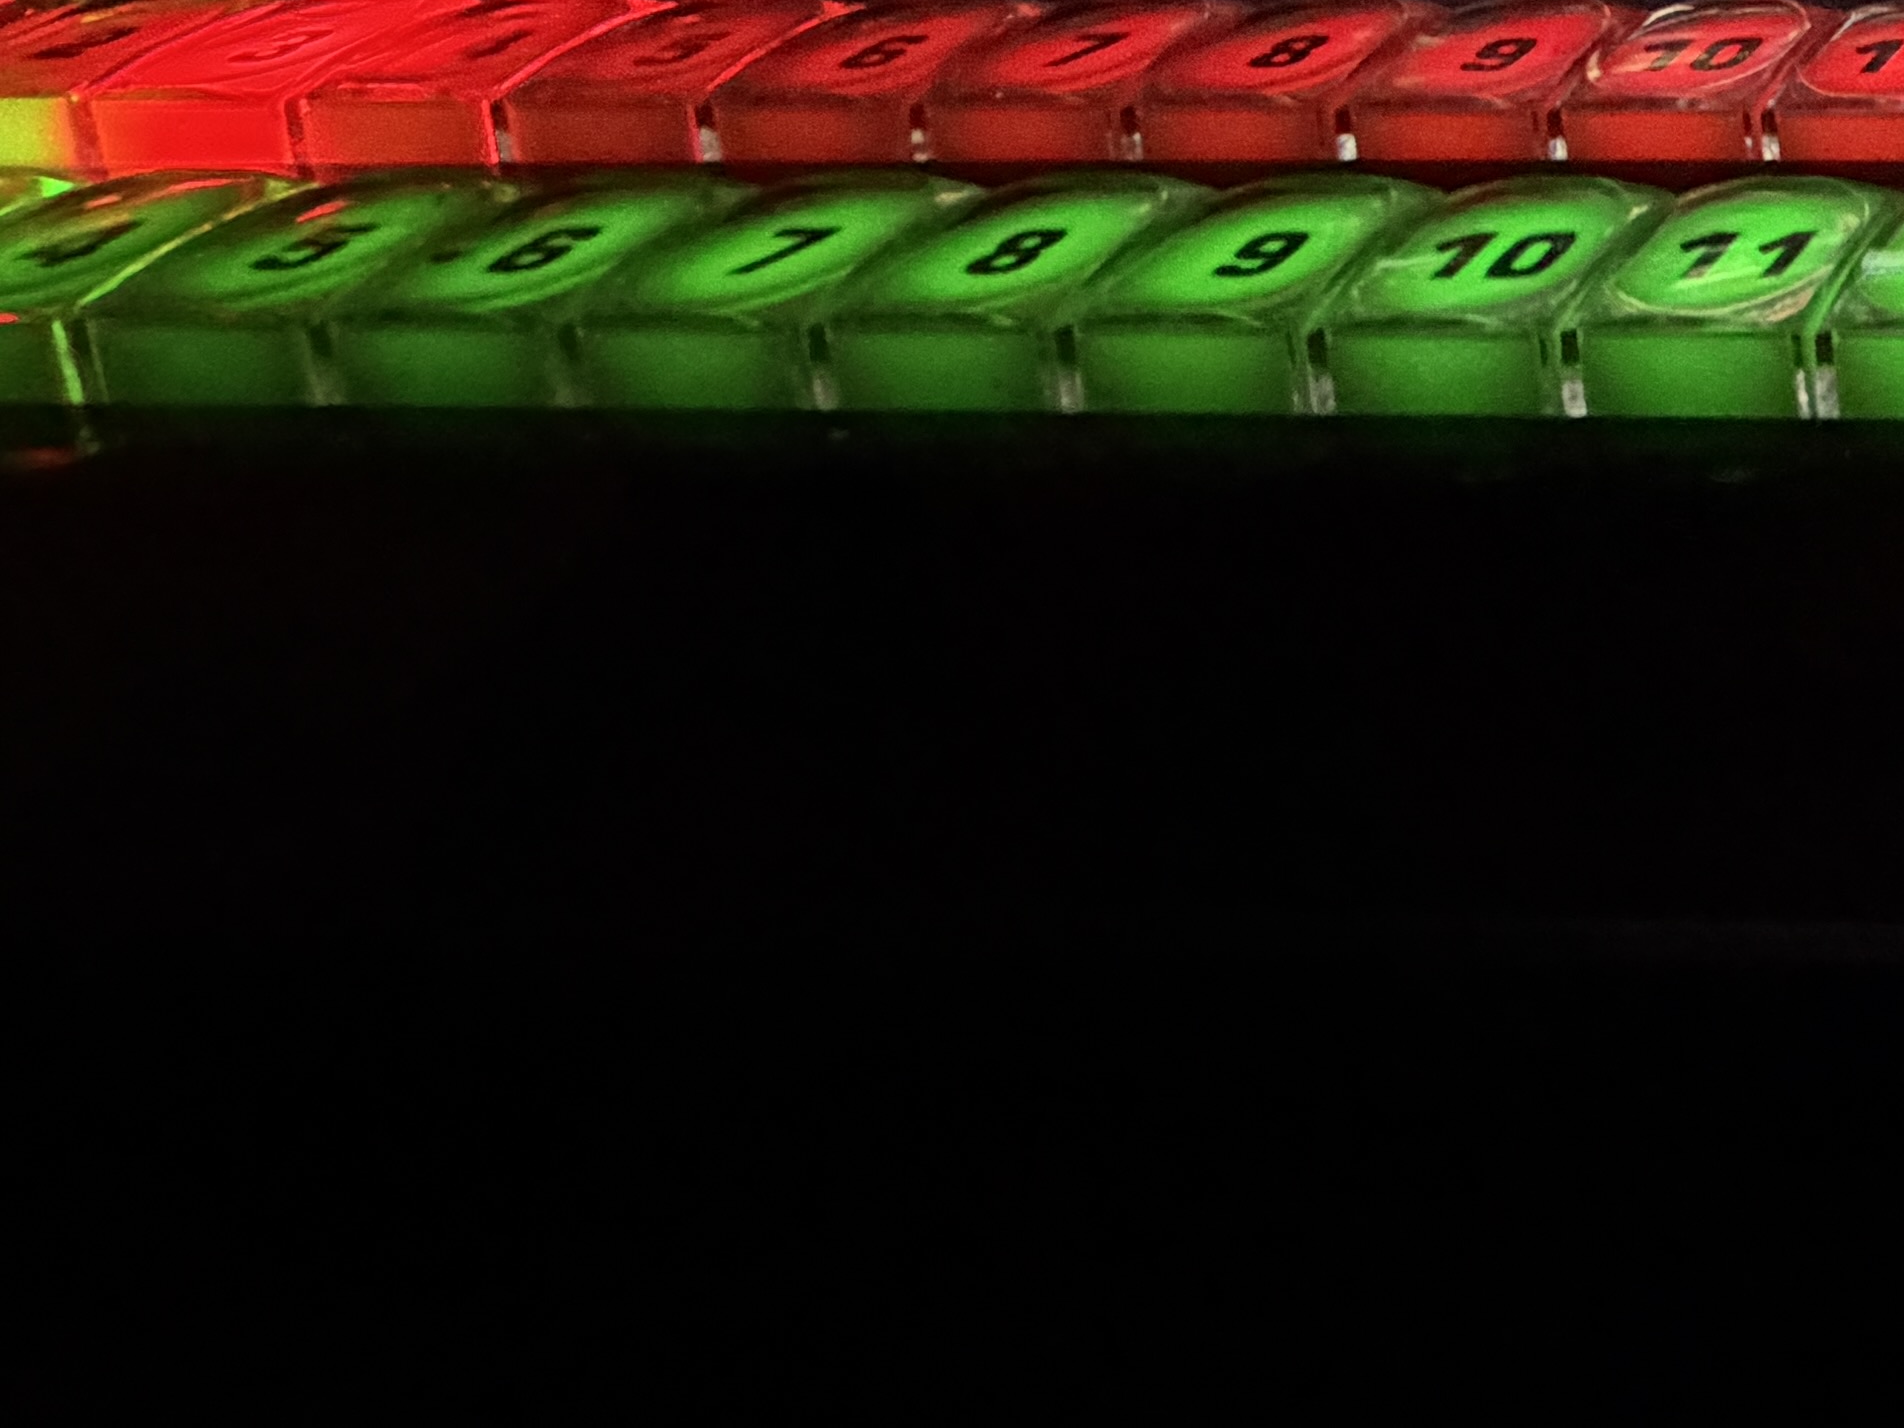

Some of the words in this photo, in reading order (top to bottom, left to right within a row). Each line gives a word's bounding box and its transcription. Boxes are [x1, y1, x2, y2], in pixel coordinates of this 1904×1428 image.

[1042, 31, 1130, 68] 7
[1248, 34, 1331, 69] 8
[1459, 36, 1539, 71] 9
[1641, 35, 1764, 72] 10
[488, 226, 606, 274] 6
[726, 226, 845, 277] 7
[965, 228, 1068, 276] 8
[1212, 231, 1310, 278] 9
[1432, 230, 1577, 279] 10
[1678, 230, 1822, 279] 11
